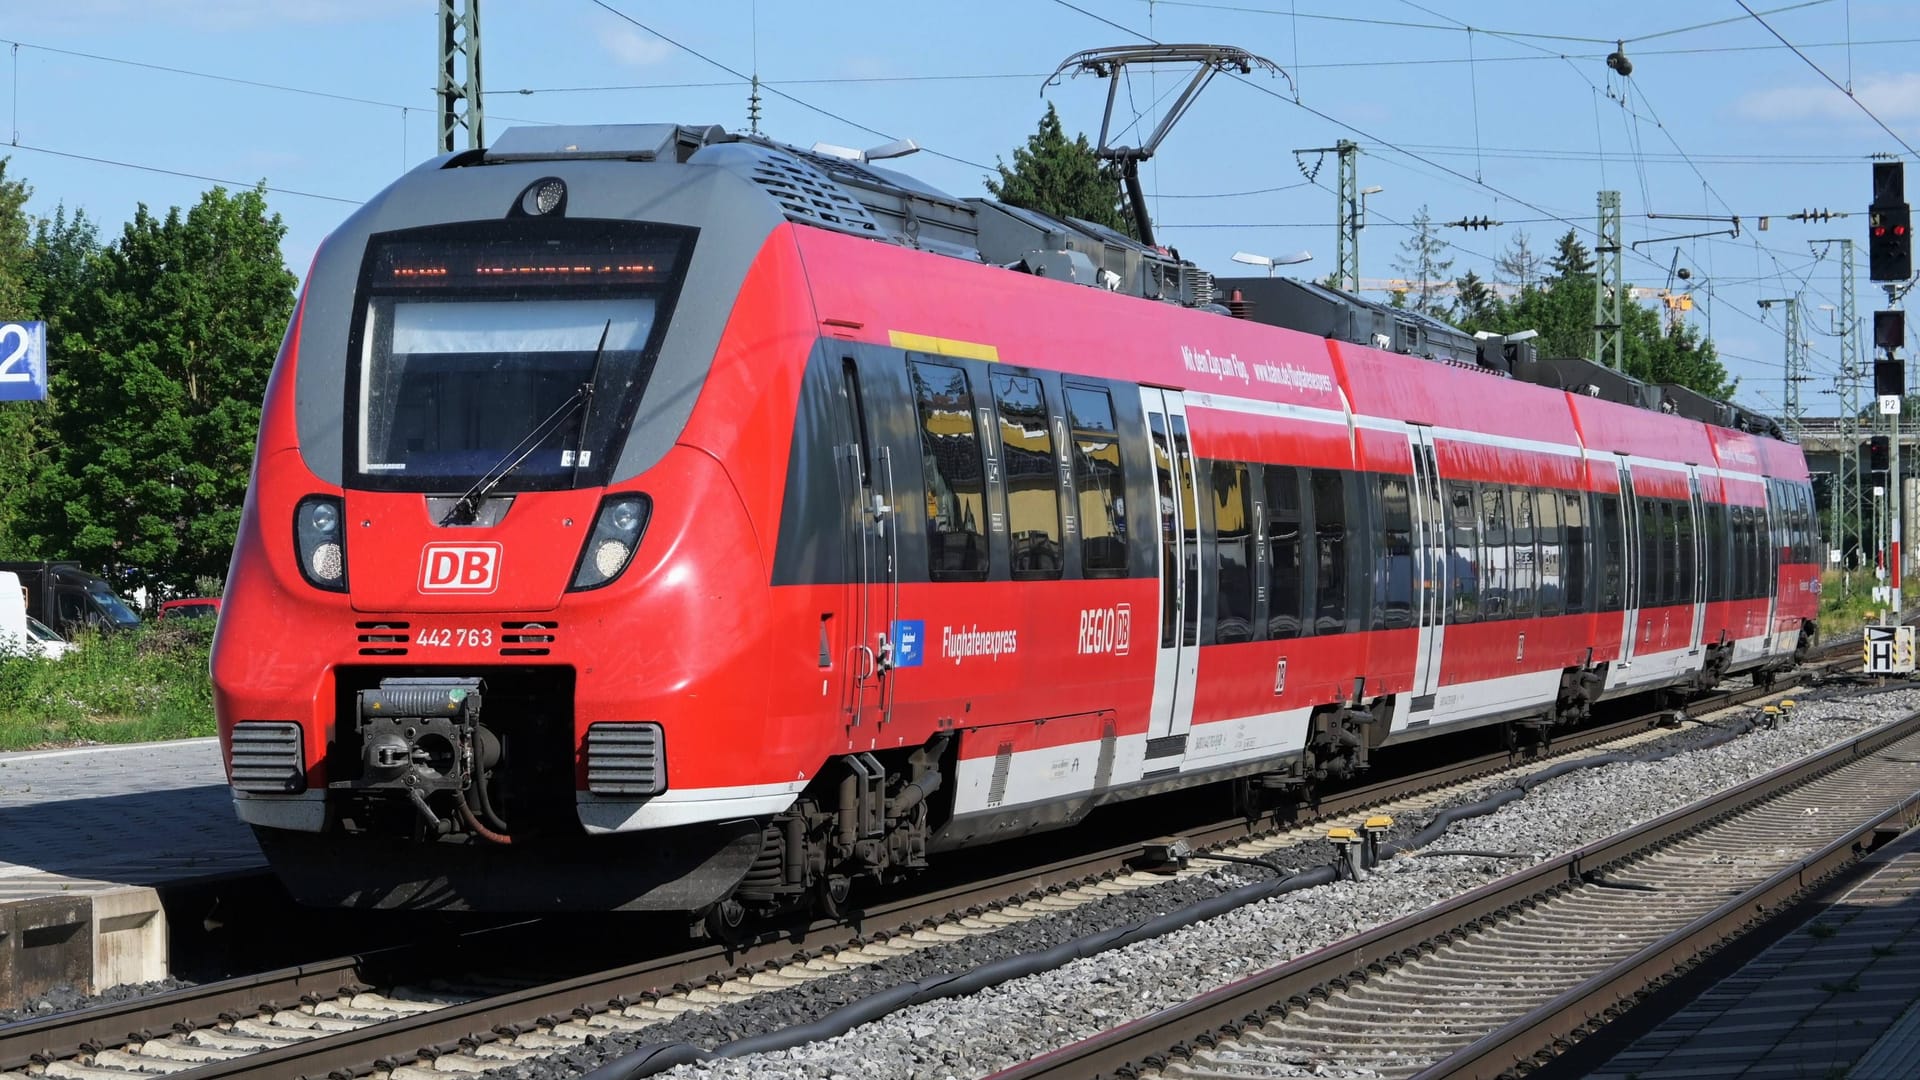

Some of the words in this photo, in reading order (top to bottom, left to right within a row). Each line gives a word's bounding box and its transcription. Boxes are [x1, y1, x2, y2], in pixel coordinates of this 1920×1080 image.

[0, 323, 31, 382] 2
[1181, 345, 1196, 371] Mit
[1194, 348, 1209, 373] dem
[1205, 349, 1223, 381] Zug
[1219, 357, 1234, 376] zum
[1885, 400, 1896, 410] P2
[984, 412, 993, 456] 1
[1057, 421, 1068, 462] 2
[1256, 505, 1263, 540] 2
[427, 550, 492, 586] DB
[416, 628, 452, 647] 442
[456, 628, 493, 647] 763
[942, 623, 1017, 666] Flughafenexpress
[1078, 608, 1115, 654] REGIO
[1117, 611, 1129, 648] DB
[1873, 643, 1890, 670] H
